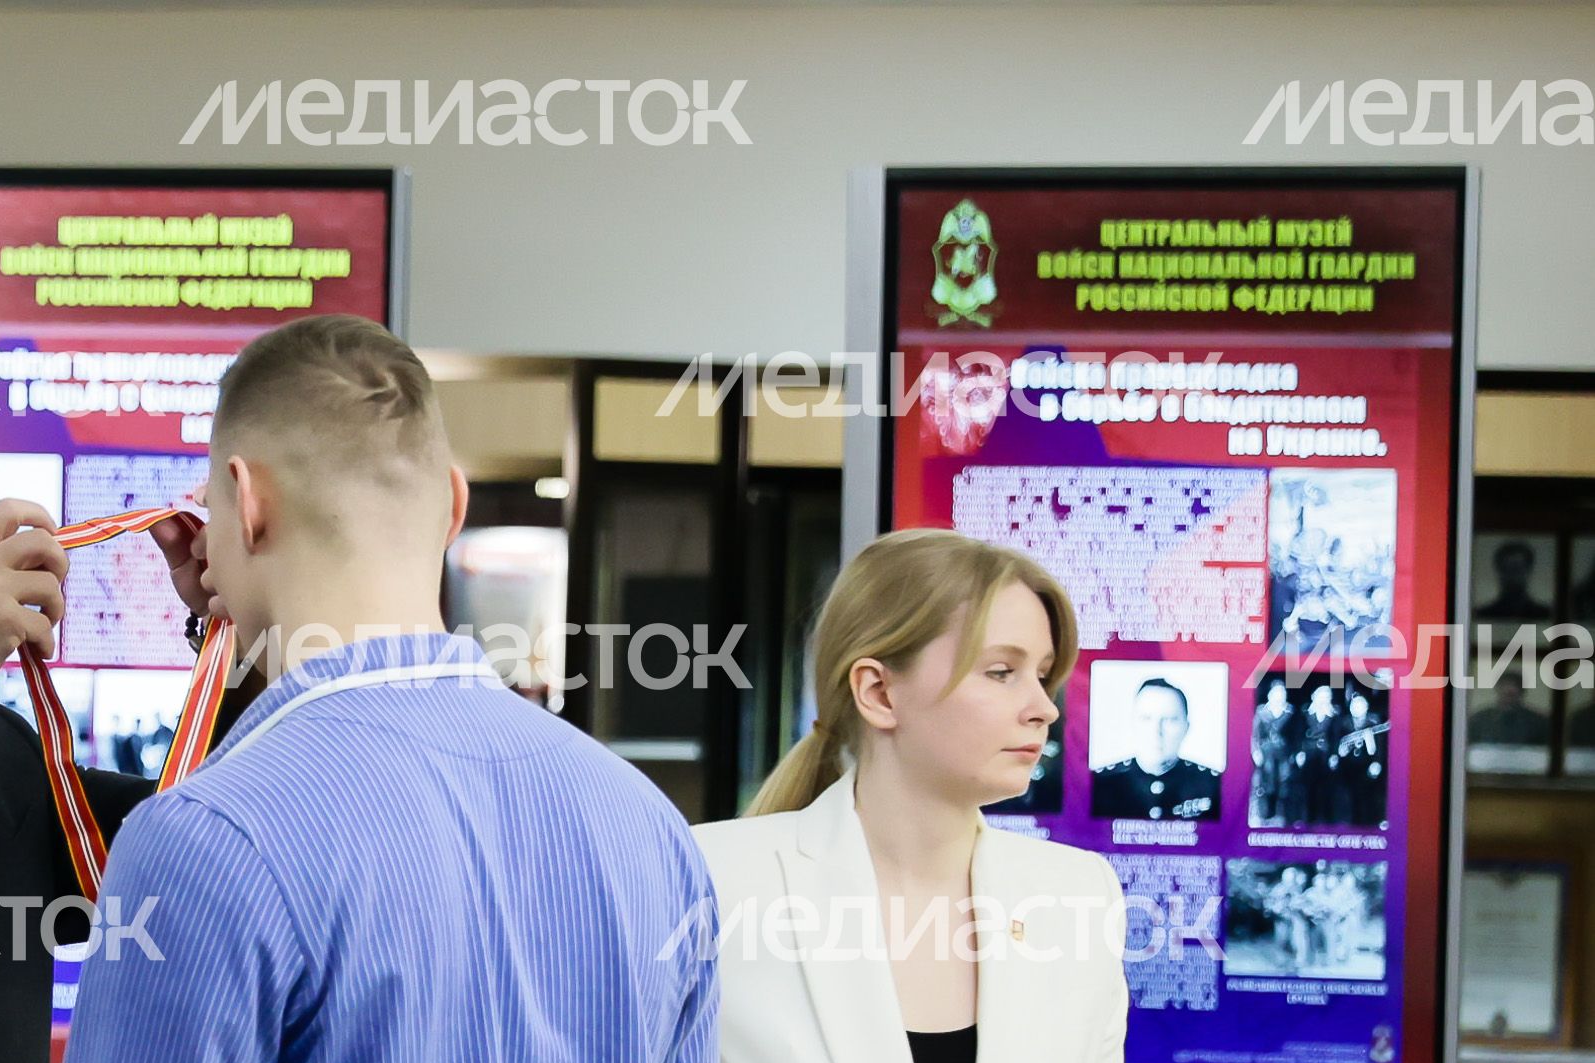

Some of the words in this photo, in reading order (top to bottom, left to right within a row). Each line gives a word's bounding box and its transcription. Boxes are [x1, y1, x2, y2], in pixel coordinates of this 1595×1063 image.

[1100, 215, 1271, 249] ЦЕНТРАЛЬНЫЙ
[1276, 215, 1353, 248] МУЗЕЙ
[1037, 248, 1115, 279] ВОЙСК
[1119, 248, 1305, 283] НАЦИОНАЛЬНОЙ
[1308, 251, 1416, 283] ГВАРДИИ
[1076, 281, 1229, 311] РОССИЙСКОЙ
[1232, 283, 1374, 313] ФЕДЕРАЦИИ
